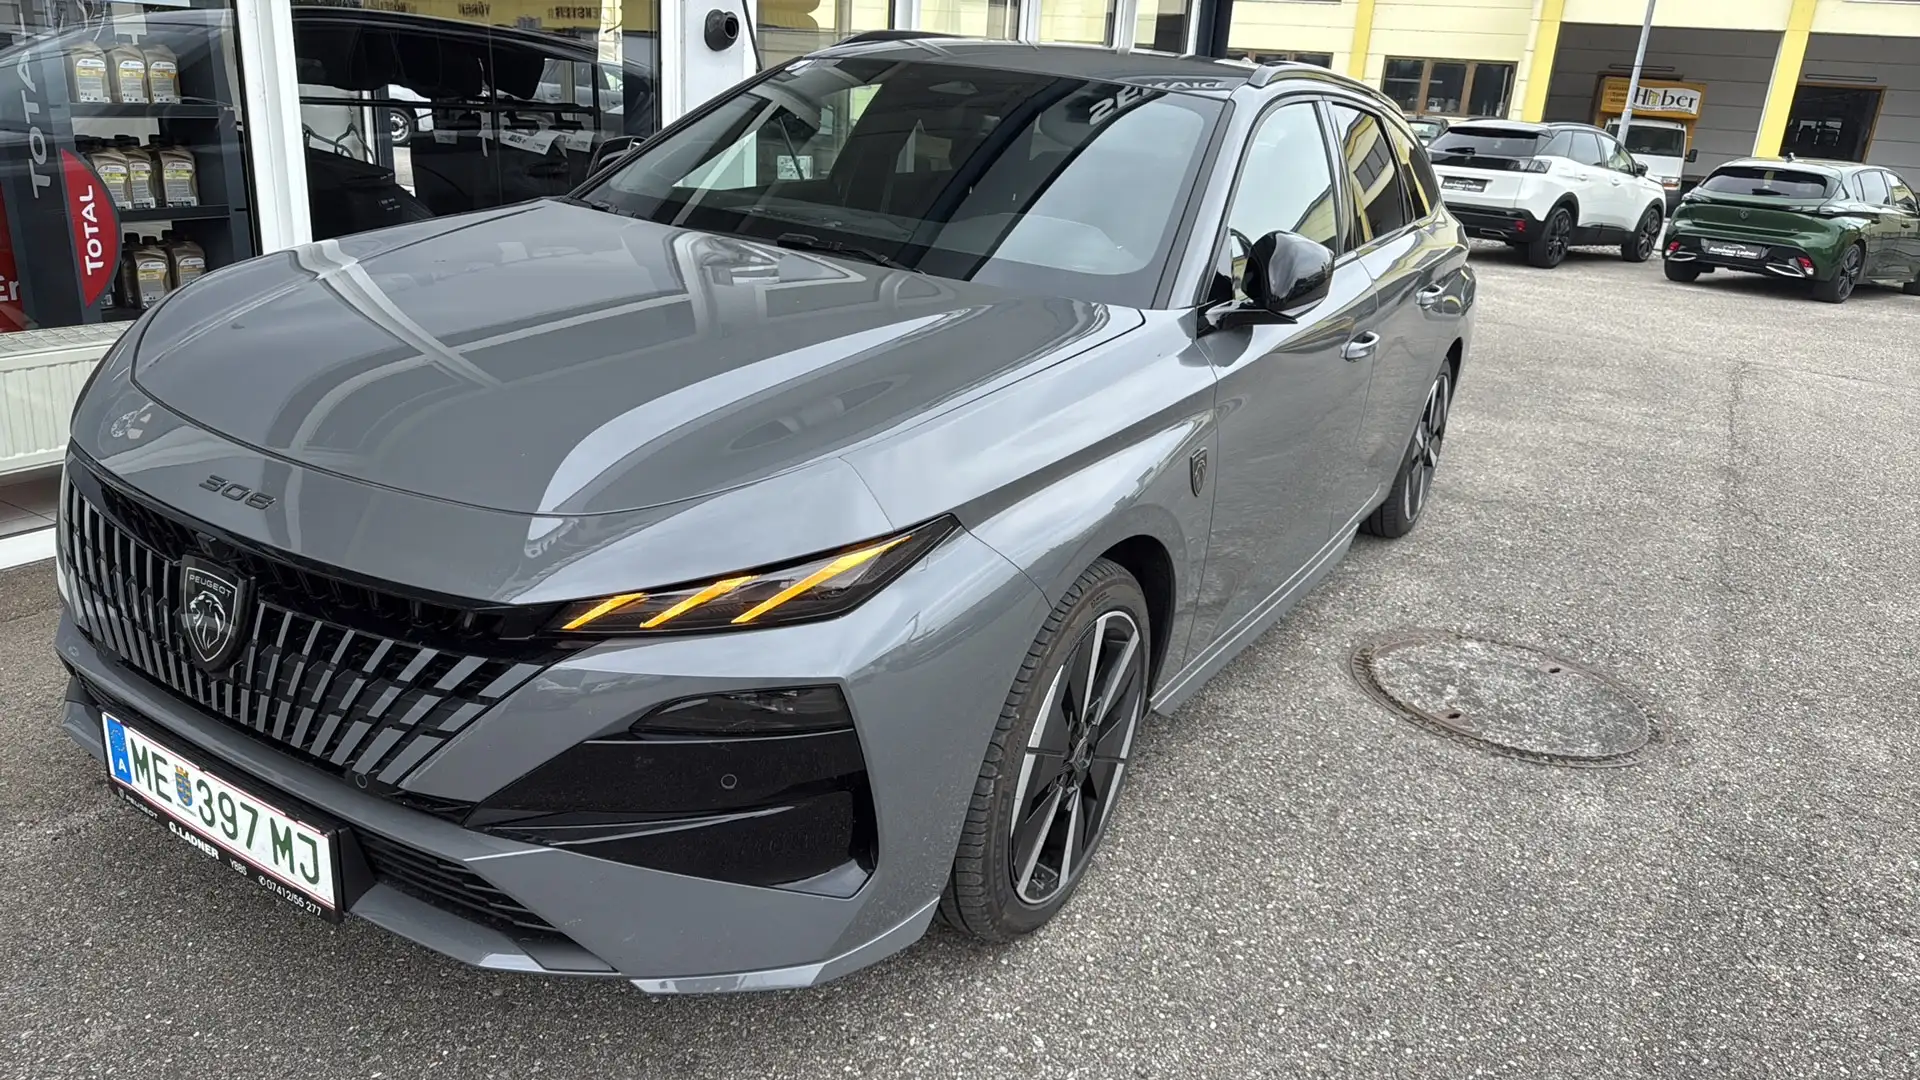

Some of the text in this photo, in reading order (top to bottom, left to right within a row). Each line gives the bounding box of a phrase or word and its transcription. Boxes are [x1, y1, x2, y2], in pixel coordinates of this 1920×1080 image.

[79, 184, 104, 276] TOTAL
[199, 474, 276, 510] 308
[189, 574, 232, 598] PEUGEOT
[118, 758, 128, 773] A
[130, 737, 319, 885] ME 397 MJ
